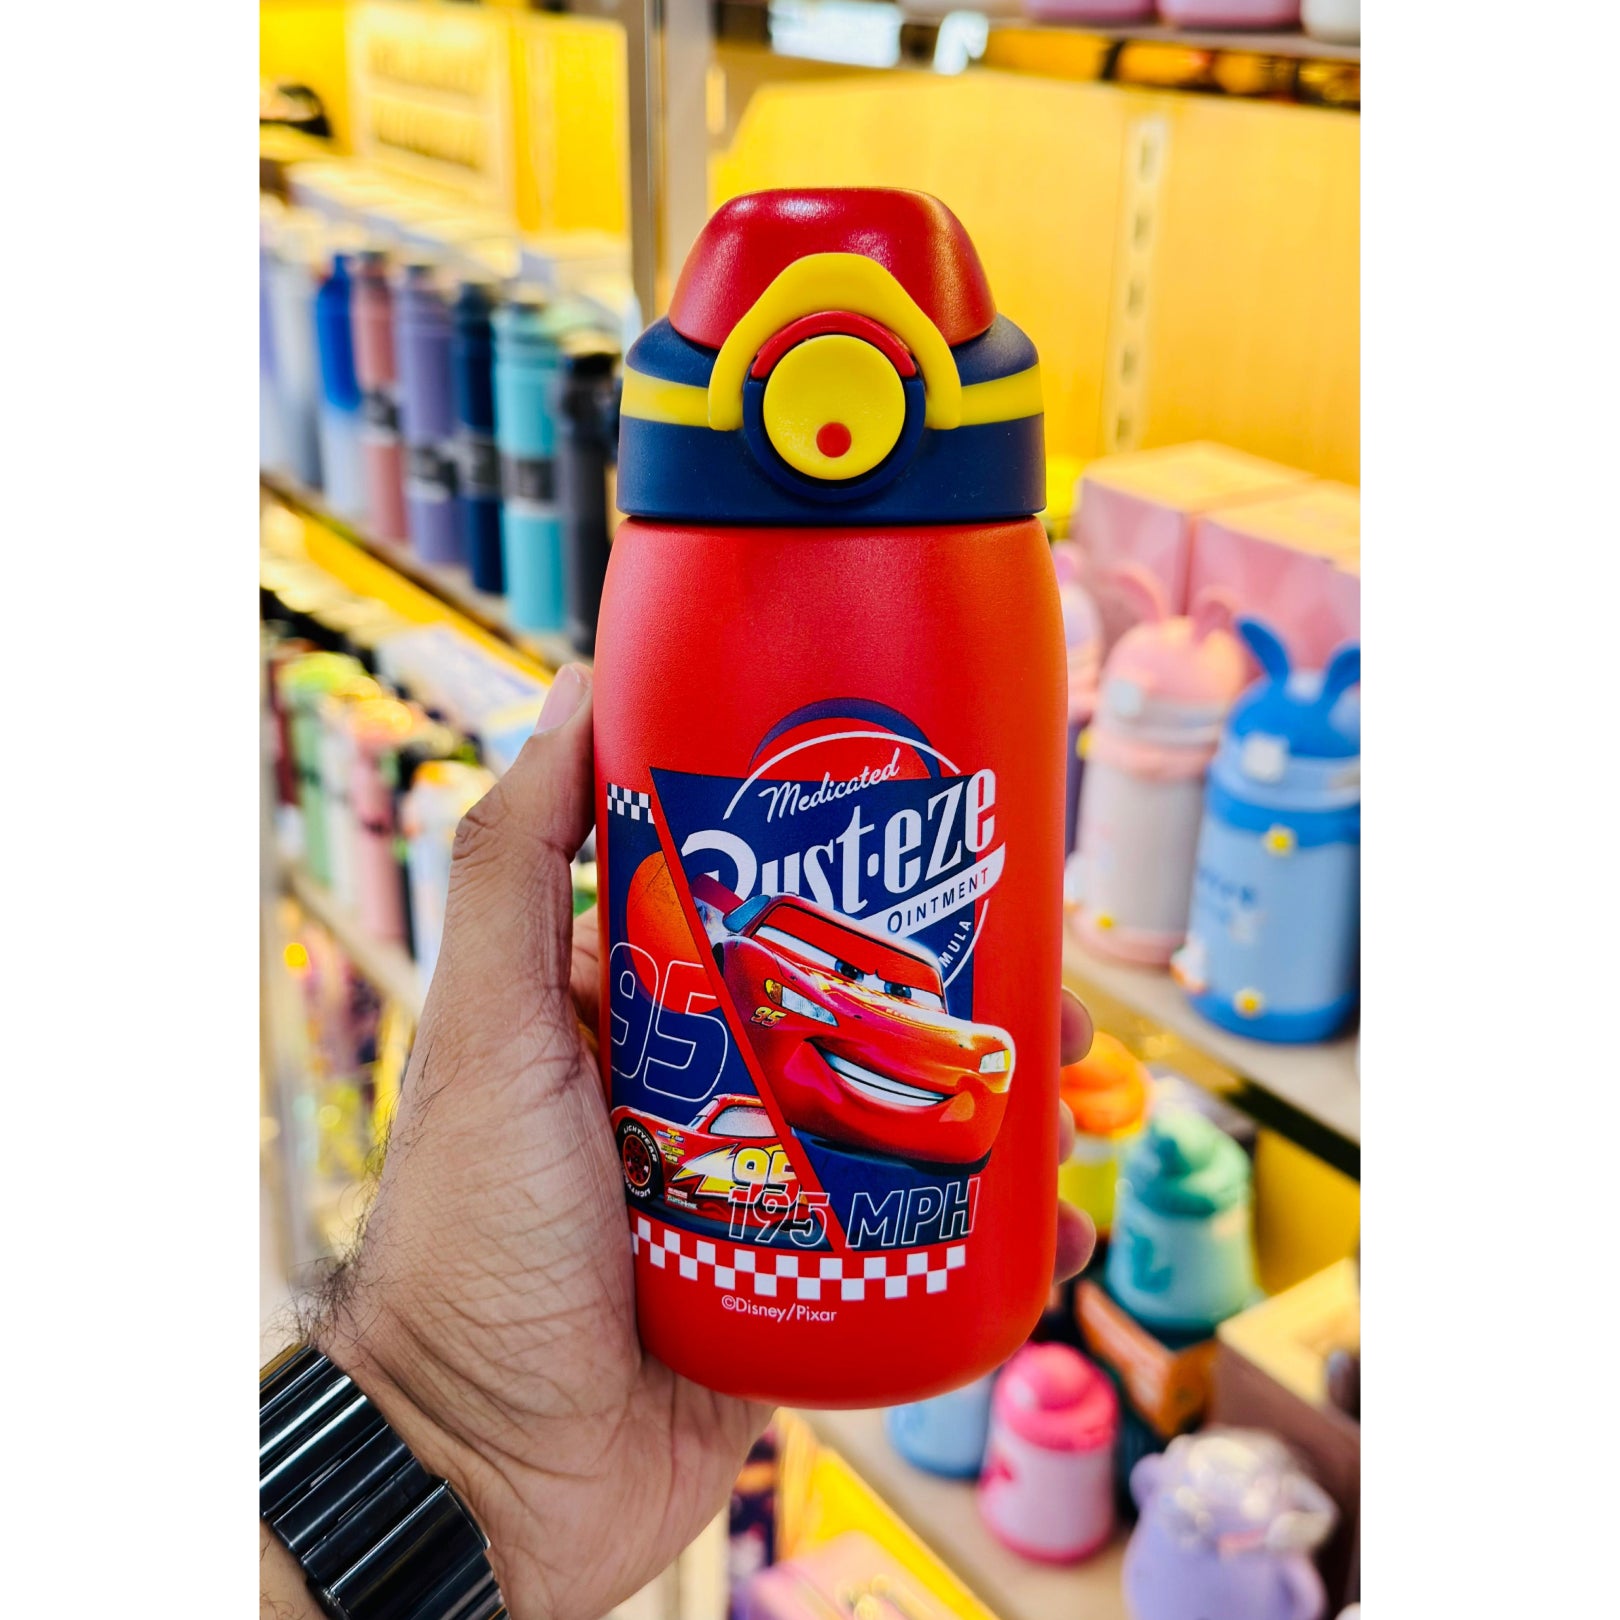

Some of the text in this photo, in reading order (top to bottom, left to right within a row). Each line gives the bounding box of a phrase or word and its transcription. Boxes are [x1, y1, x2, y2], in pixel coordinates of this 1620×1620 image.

[757, 747, 901, 823] Medicated
[886, 867, 989, 934] OINTMENT
[938, 919, 972, 969] MULA
[609, 941, 729, 1103] 95
[750, 1006, 788, 1028] 95
[728, 1176, 981, 1249] 195 MPH
